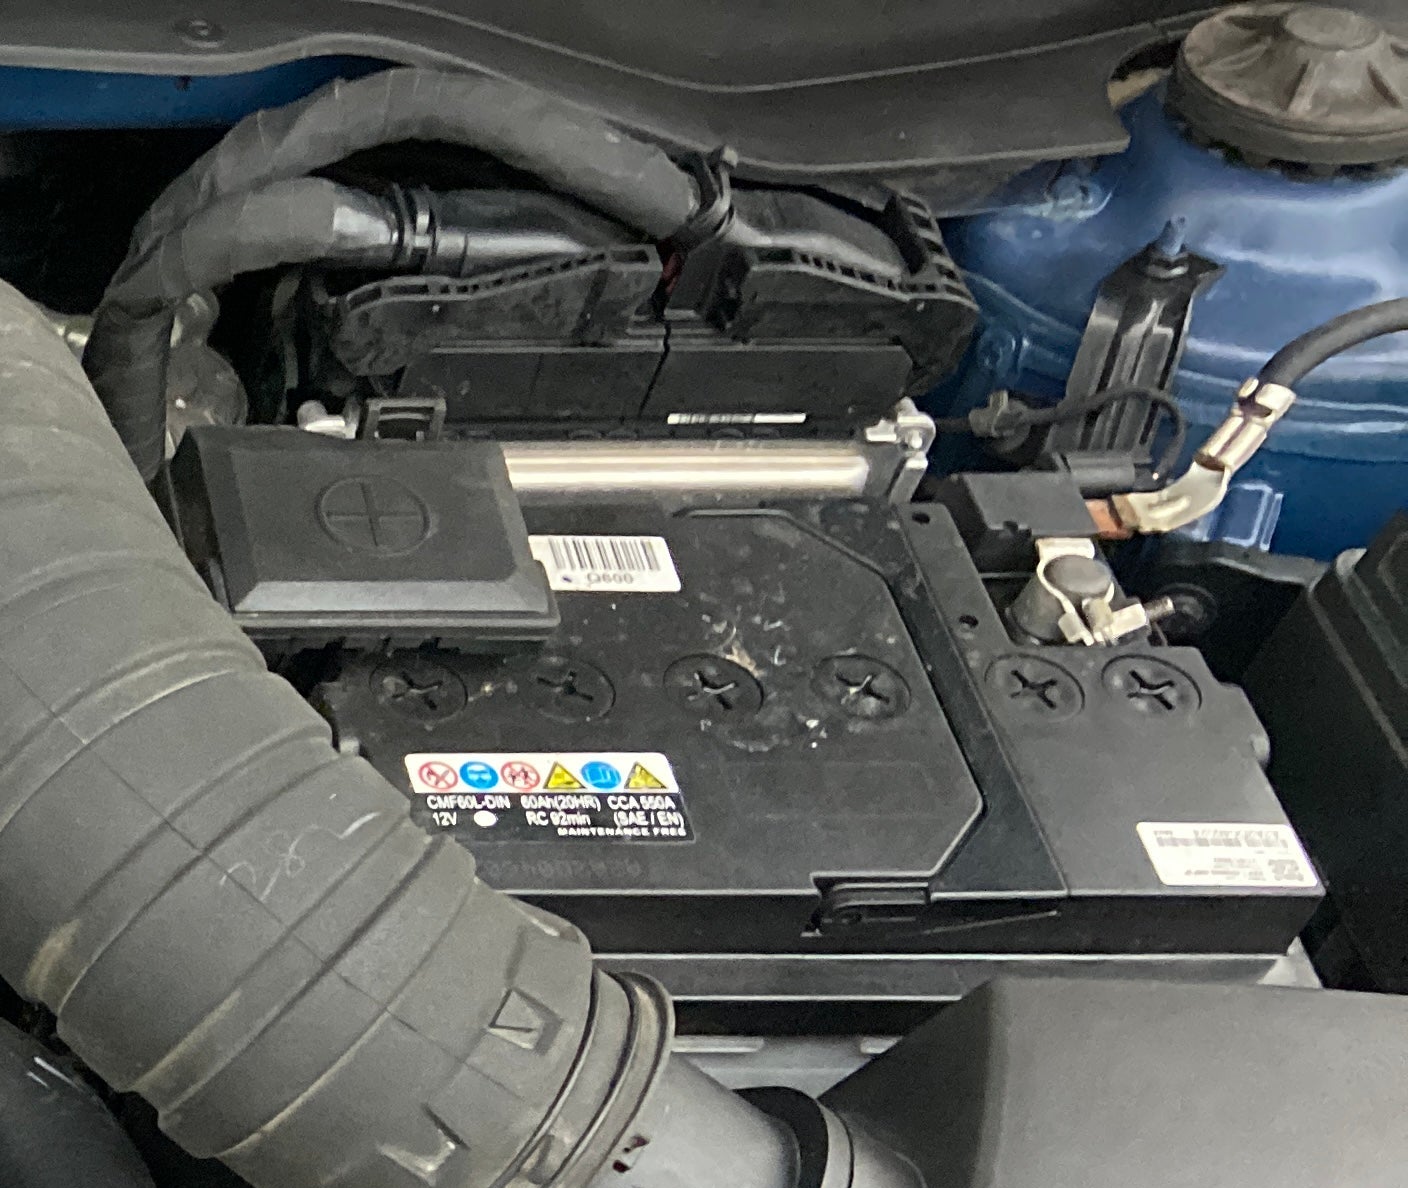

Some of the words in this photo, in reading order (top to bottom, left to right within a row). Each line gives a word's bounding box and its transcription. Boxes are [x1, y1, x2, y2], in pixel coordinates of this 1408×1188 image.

[608, 795, 640, 809] CCA
[432, 812, 457, 826] 12V
[525, 812, 548, 826] RC
[557, 827, 650, 837] MAINTENANCE
[651, 827, 686, 837] FREE
